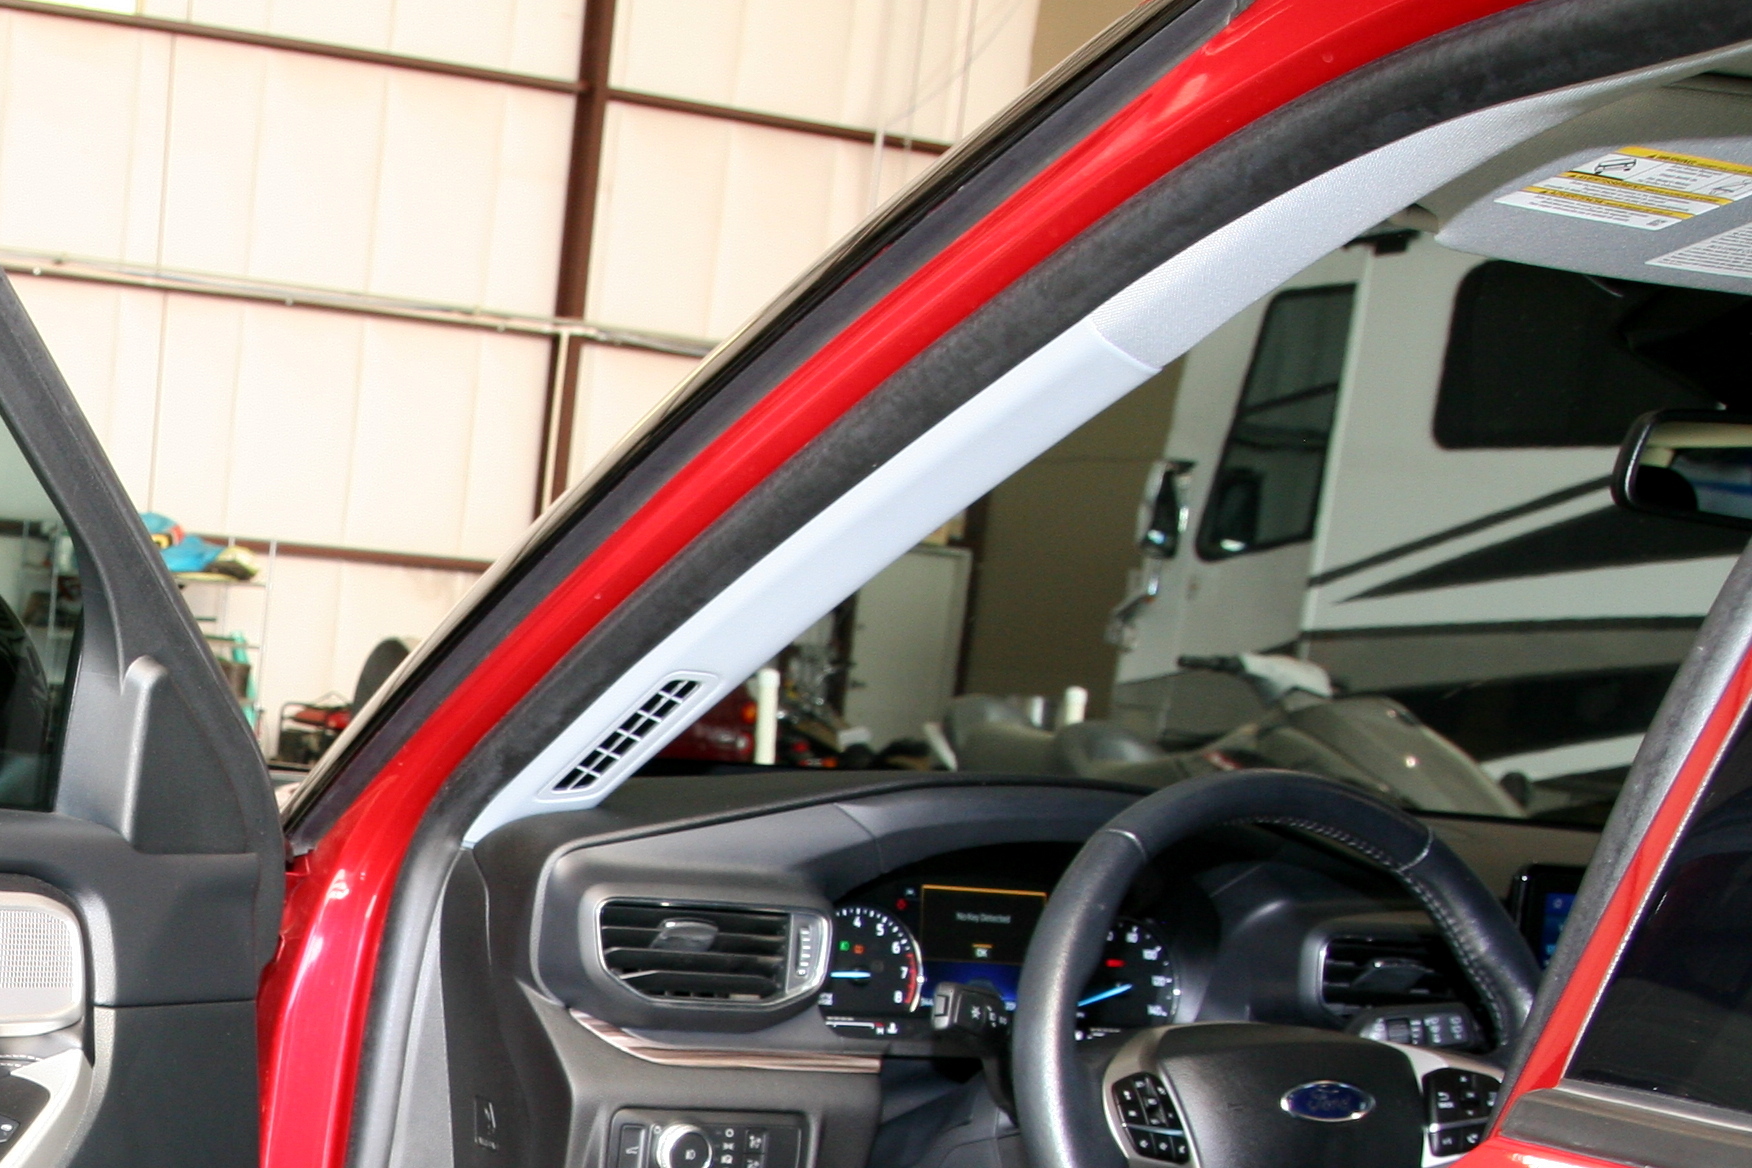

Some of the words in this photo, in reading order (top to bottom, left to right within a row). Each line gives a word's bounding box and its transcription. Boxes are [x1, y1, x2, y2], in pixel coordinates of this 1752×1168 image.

[852, 916, 862, 928] 4
[876, 923, 885, 936] 5
[891, 941, 901, 954] 6
[976, 948, 988, 958] OK
[899, 966, 909, 979] 7
[893, 990, 903, 1003] 8
